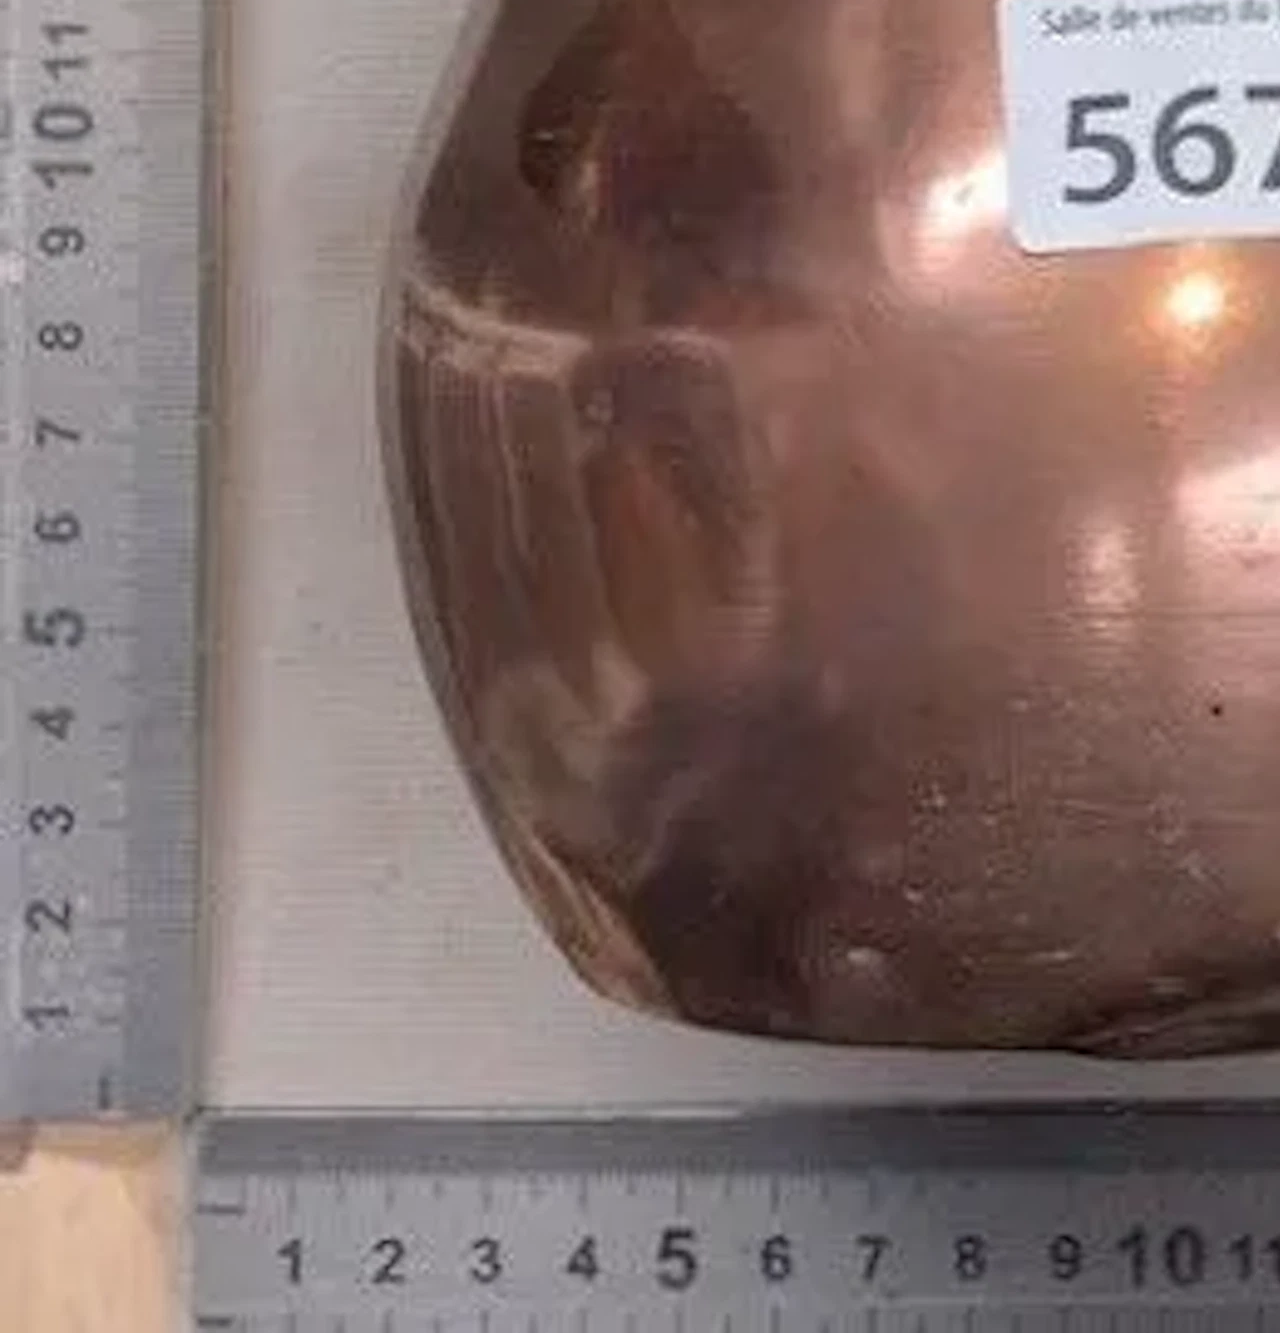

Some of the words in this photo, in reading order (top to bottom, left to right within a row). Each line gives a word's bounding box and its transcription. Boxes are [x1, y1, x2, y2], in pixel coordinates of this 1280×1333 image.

[1041, 4, 1101, 37] Salle
[41, 23, 89, 82] 11
[31, 102, 95, 190] 10
[37, 225, 87, 258] 9
[37, 321, 84, 352] 8
[35, 418, 81, 448] 7
[33, 511, 81, 545] 6
[24, 607, 86, 648] 5
[30, 707, 74, 740] 4
[29, 805, 75, 836] 3
[26, 899, 72, 933] 2
[23, 1004, 70, 1031] 1
[277, 1238, 303, 1285] 1
[371, 1236, 408, 1285] 2
[469, 1236, 503, 1285] 3
[565, 1235, 601, 1283] 4
[656, 1226, 698, 1292] 5
[759, 1234, 792, 1283] 6
[856, 1235, 890, 1282] 7
[952, 1235, 987, 1281] 8
[1048, 1234, 1082, 1281] 9
[1117, 1226, 1206, 1287] 10
